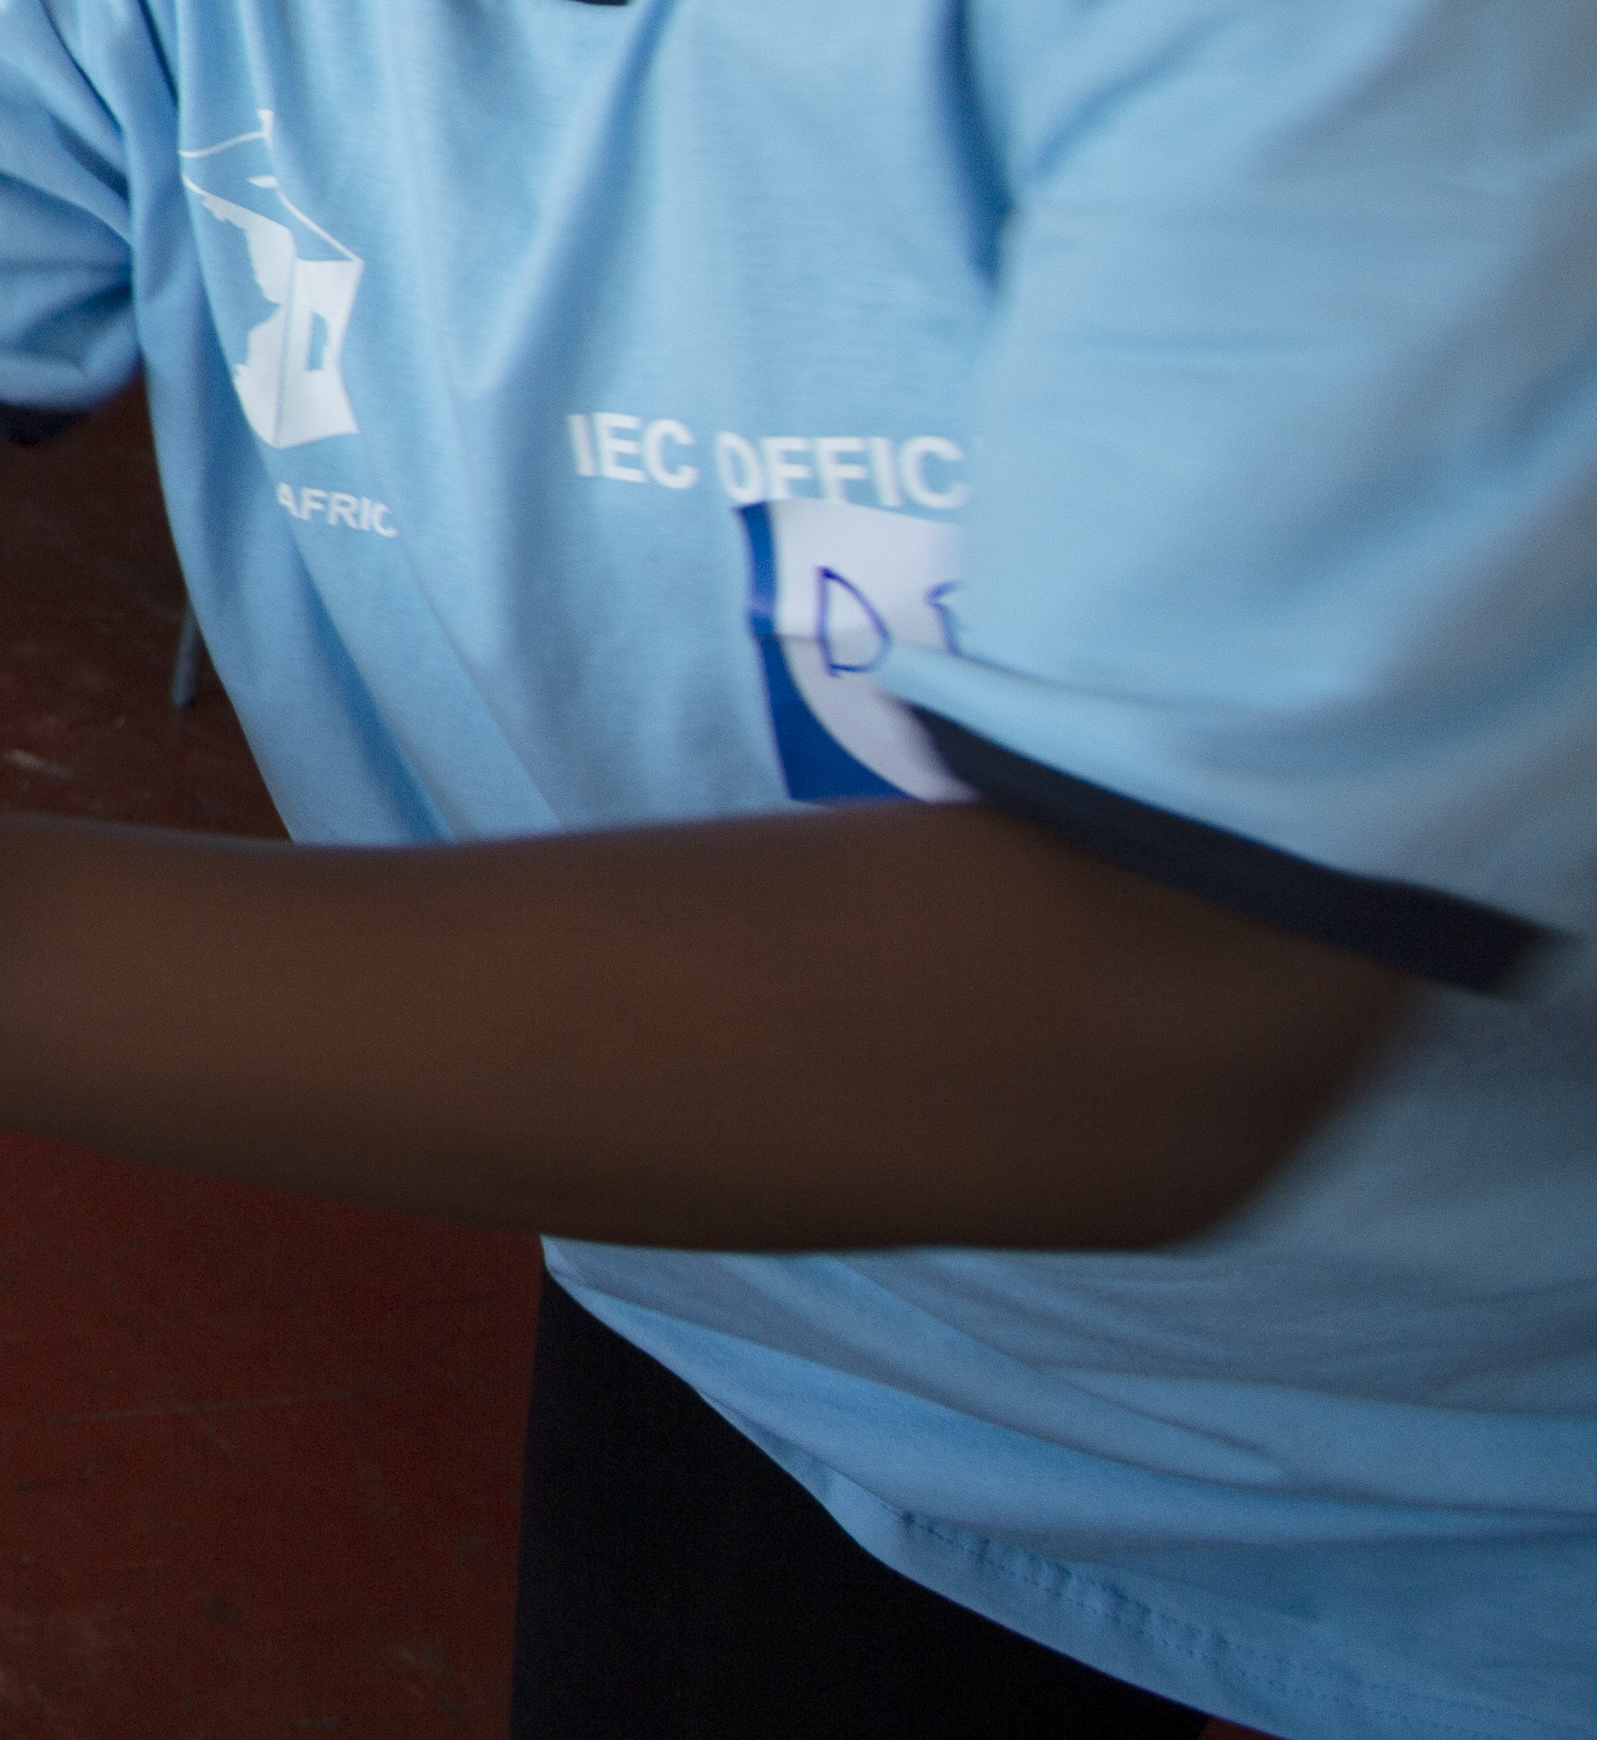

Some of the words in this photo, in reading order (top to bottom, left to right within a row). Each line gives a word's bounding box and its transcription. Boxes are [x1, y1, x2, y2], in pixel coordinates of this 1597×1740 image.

[567, 412, 700, 491] IEC
[716, 430, 973, 510] OFFIC
[276, 480, 399, 539] AFRIC
